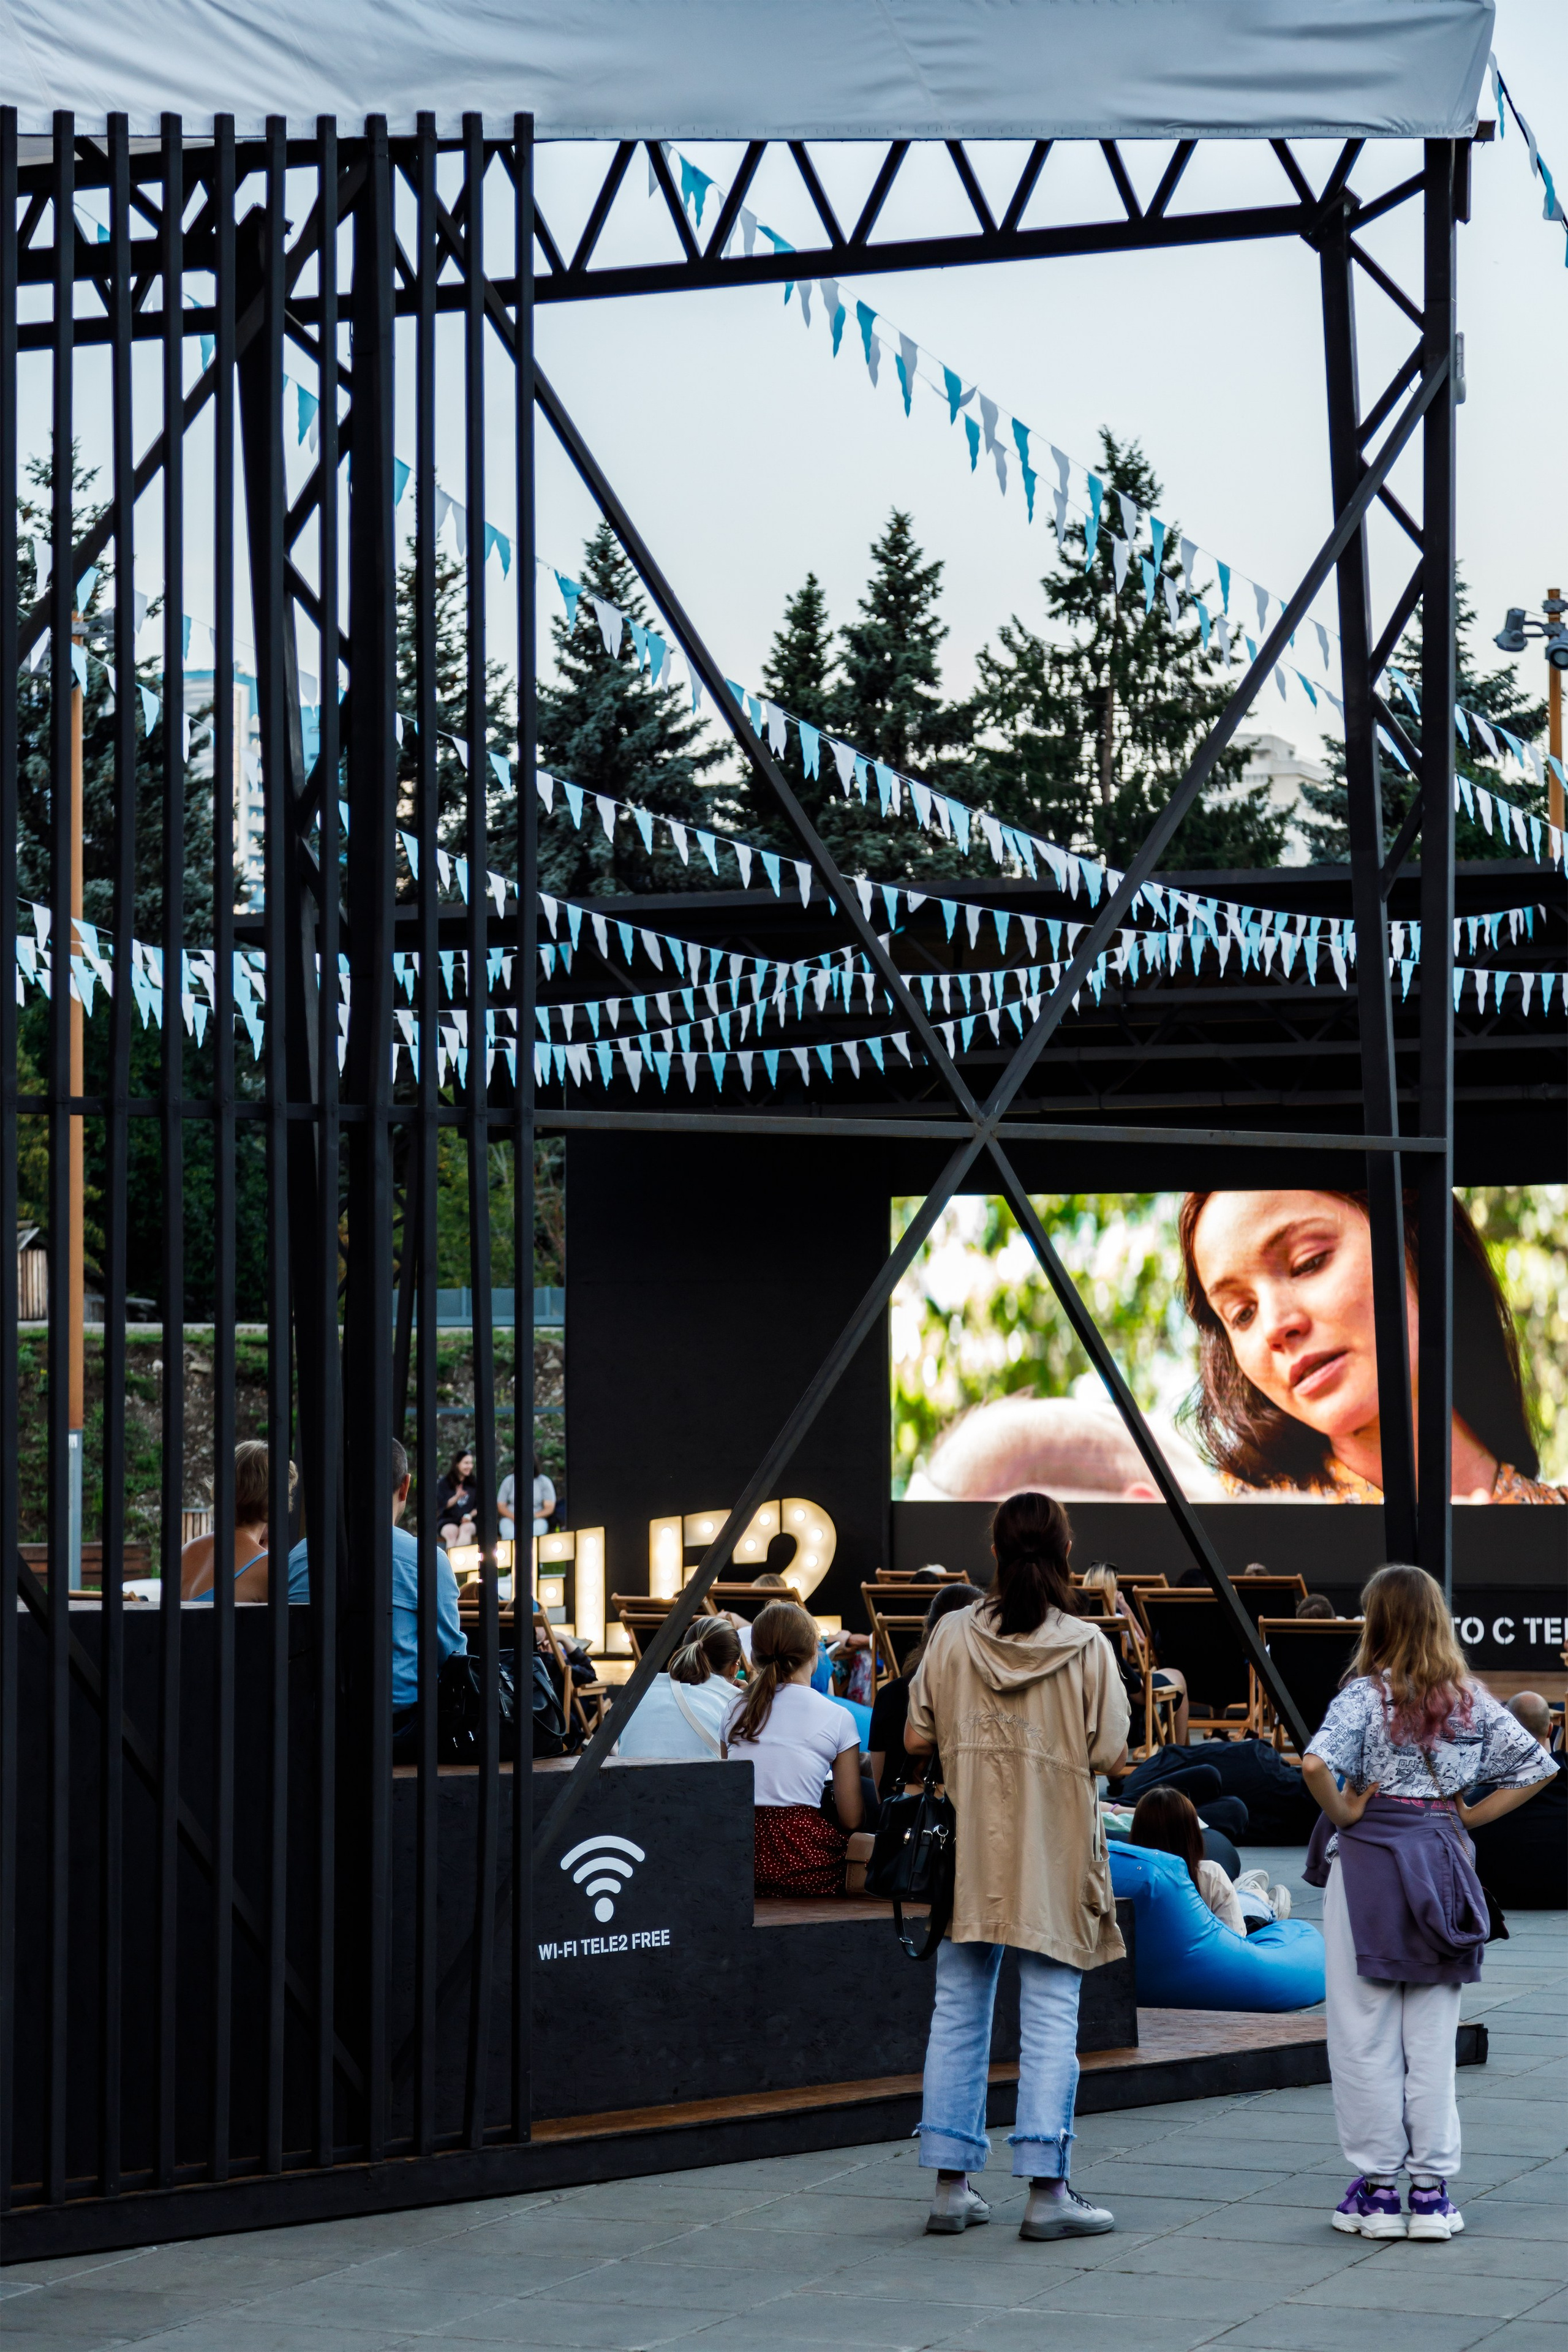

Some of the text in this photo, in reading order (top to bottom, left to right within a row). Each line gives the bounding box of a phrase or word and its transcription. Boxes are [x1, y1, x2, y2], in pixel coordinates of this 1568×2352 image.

[538, 1929, 670, 1961] WI-FI TELE2 FREE
